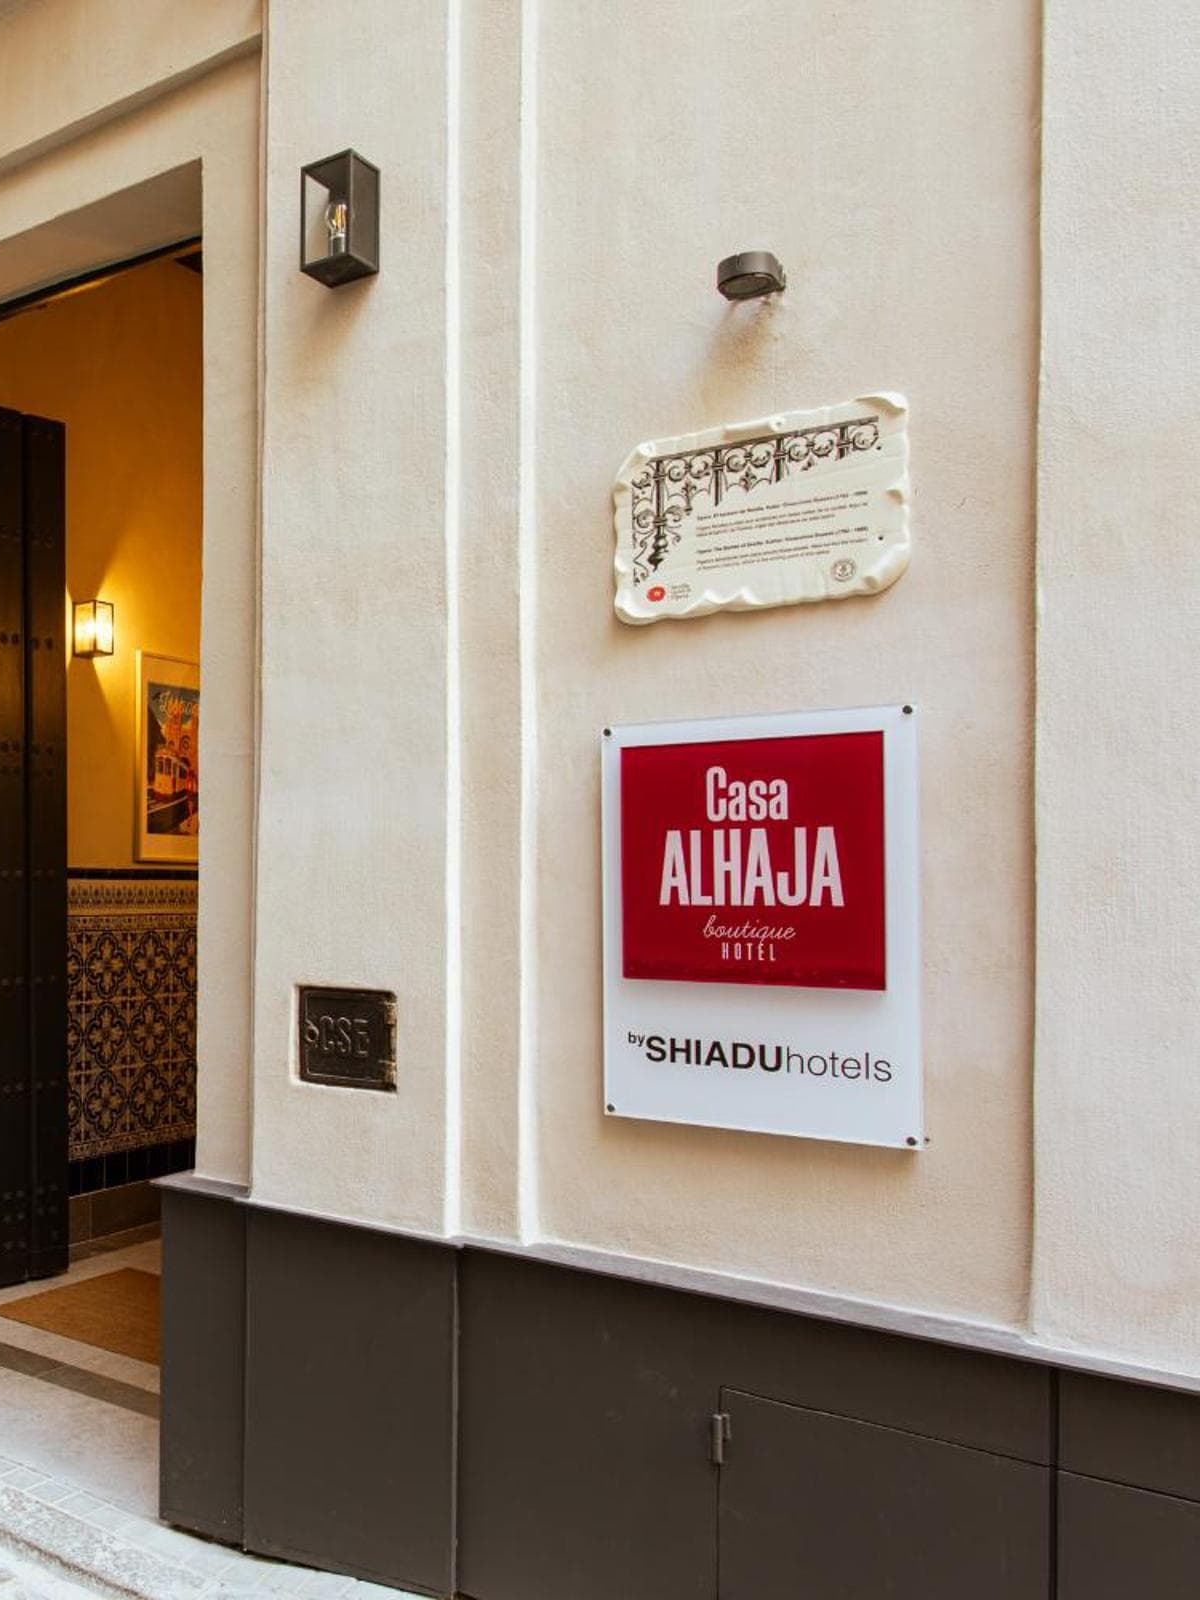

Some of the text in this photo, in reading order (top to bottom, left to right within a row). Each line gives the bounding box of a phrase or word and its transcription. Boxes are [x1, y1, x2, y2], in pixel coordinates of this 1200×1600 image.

[706, 766, 789, 822] Casa
[659, 826, 845, 907] ALHAJA
[703, 914, 796, 943] boutique
[721, 942, 777, 962] HOTEL
